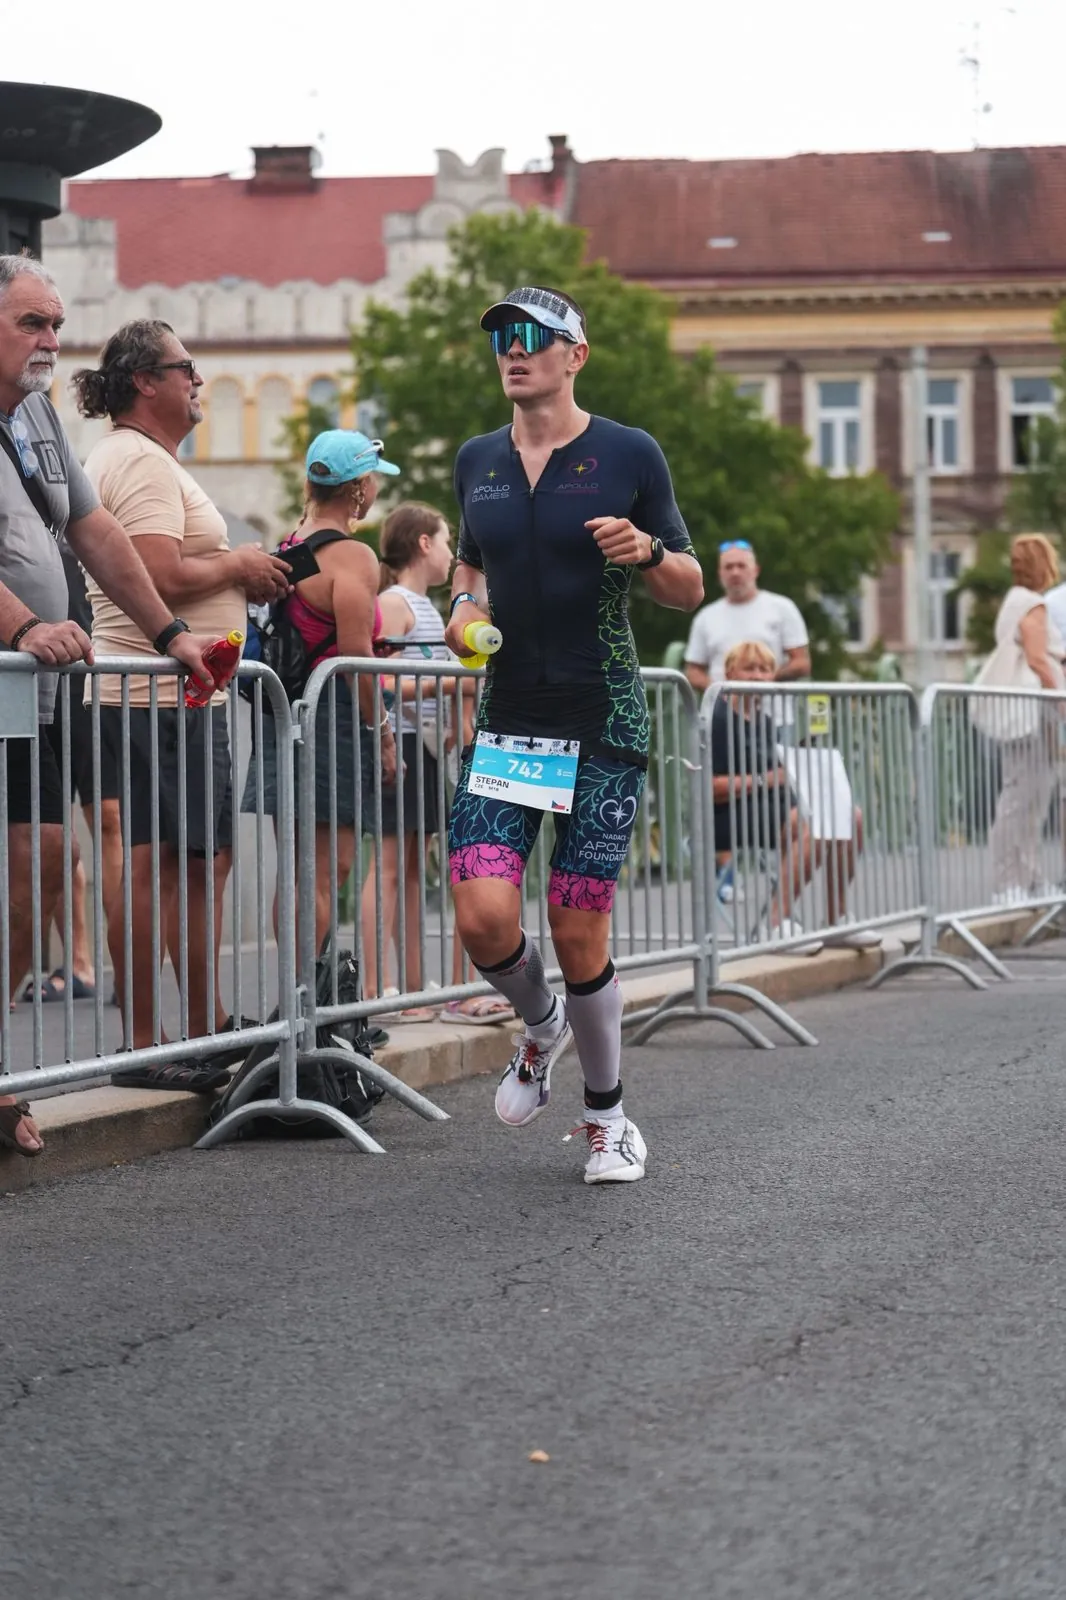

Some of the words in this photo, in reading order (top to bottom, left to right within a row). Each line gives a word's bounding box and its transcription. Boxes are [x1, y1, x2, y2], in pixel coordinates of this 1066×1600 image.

[473, 484, 510, 494] APOLLO
[471, 491, 510, 503] GAMES
[512, 740, 543, 748] IRONAN
[507, 759, 544, 780] 742
[475, 776, 510, 789] STEPAN
